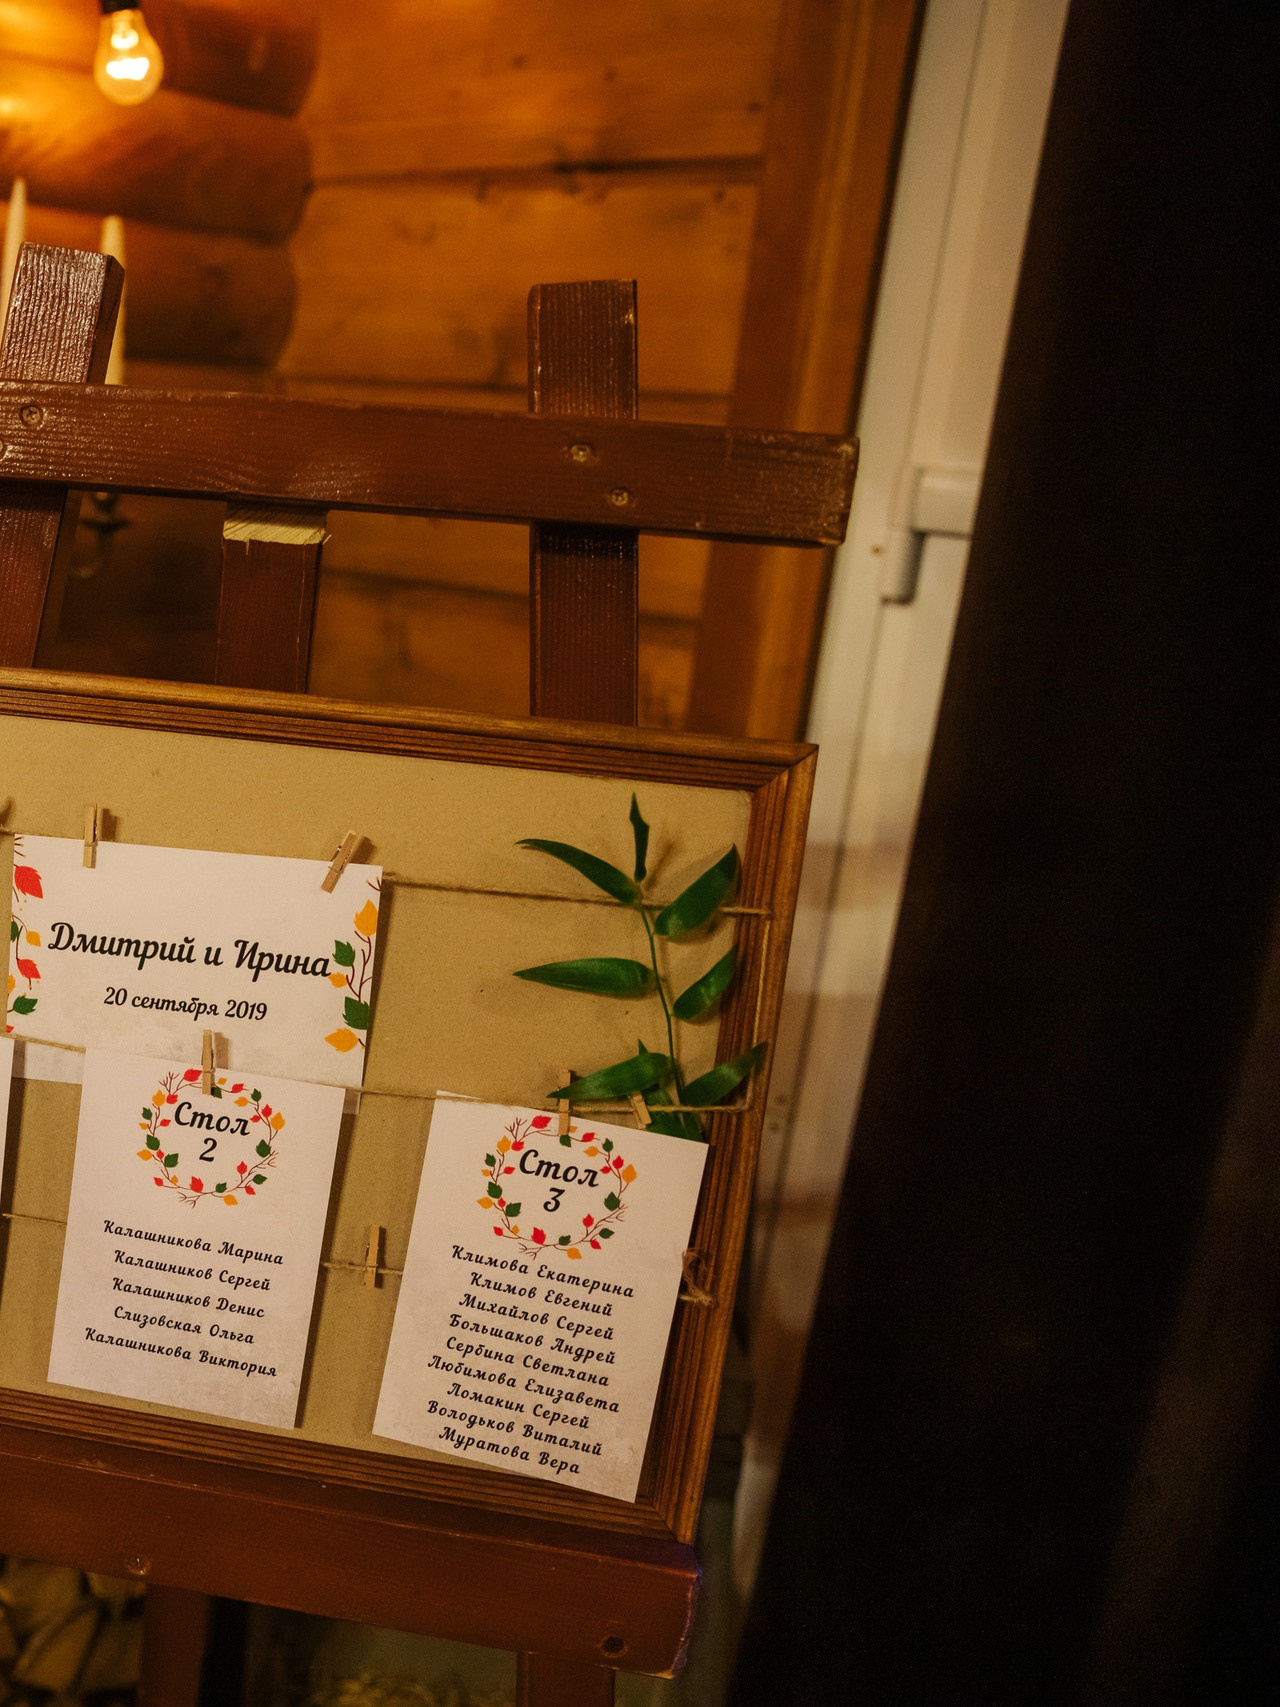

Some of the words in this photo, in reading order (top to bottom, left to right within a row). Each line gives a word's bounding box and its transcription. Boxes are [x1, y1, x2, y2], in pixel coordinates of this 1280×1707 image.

[48, 922, 196, 971] Дмитрий
[204, 946, 224, 966] и
[234, 939, 331, 982] Ирина
[104, 987, 128, 1006] 20
[131, 996, 219, 1021] сентября
[224, 999, 267, 1021] 2019
[174, 1101, 250, 1136] Стол
[199, 1137, 217, 1162] 2
[519, 1149, 599, 1187] Стол
[543, 1187, 565, 1212] 3
[104, 1220, 211, 1252] Калашникова
[218, 1241, 283, 1265] Марина
[115, 1250, 213, 1280] Калашников
[219, 1270, 270, 1291] Сергей
[452, 1245, 528, 1274] Климова
[537, 1264, 633, 1297] Екатерина
[113, 1277, 211, 1307] Калашников
[215, 1297, 264, 1318] Денис
[459, 1293, 549, 1325] Михайлов
[556, 1316, 613, 1340] Сергей
[471, 1272, 537, 1299] Климов
[544, 1289, 612, 1316] Евгений
[114, 1306, 201, 1334] Слизовская
[209, 1324, 254, 1344] Ольга
[449, 1314, 544, 1347] Большаков
[550, 1338, 615, 1364] Андрей
[85, 1327, 191, 1360] Калашникова
[199, 1350, 277, 1377] Виктория
[446, 1336, 514, 1364] Сербина
[523, 1355, 608, 1386] Светлана
[428, 1355, 516, 1388] Любимова
[524, 1378, 619, 1413] Елизавета
[447, 1383, 524, 1413] Ломакин
[533, 1404, 589, 1429] Сергей
[427, 1400, 515, 1433] Володьков
[522, 1424, 602, 1456] Виталий
[438, 1426, 530, 1461] Муратова
[538, 1451, 579, 1475] Вера
